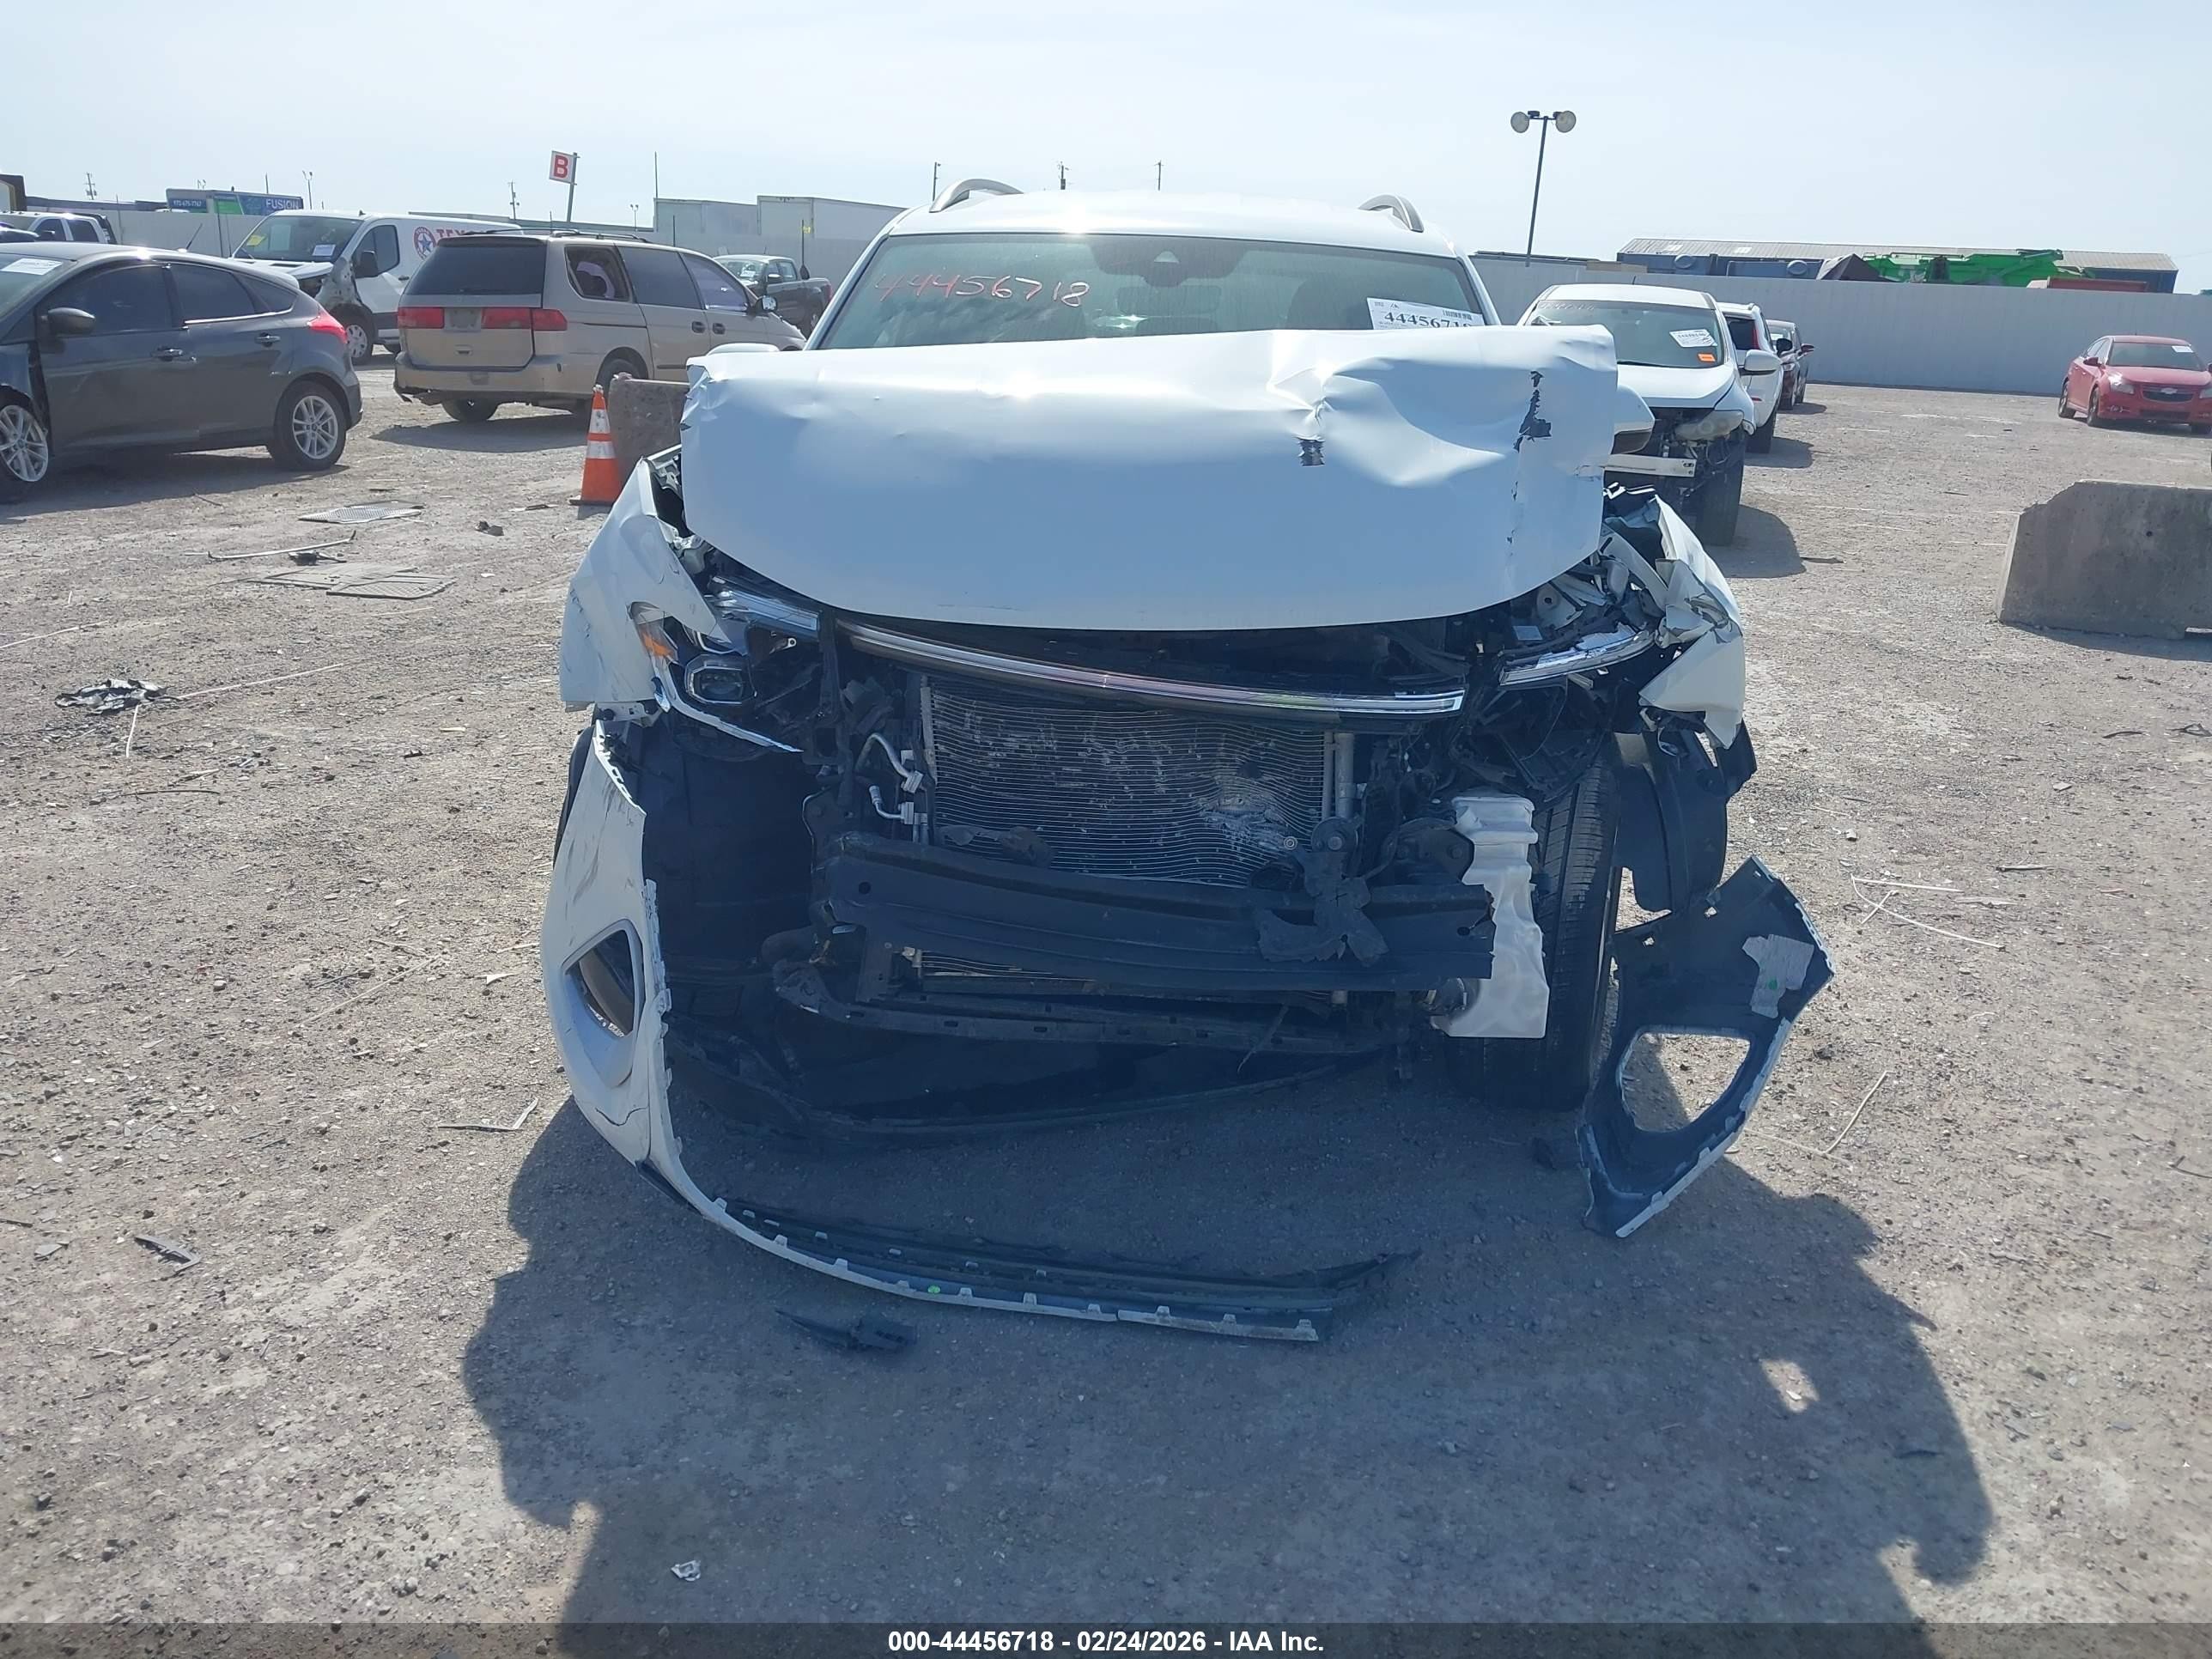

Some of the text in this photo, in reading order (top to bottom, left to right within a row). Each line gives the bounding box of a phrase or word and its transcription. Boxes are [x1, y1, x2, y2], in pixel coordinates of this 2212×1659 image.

[554, 155, 568, 179] B
[265, 198, 300, 210] FUSION
[874, 273, 1090, 307] 44456718
